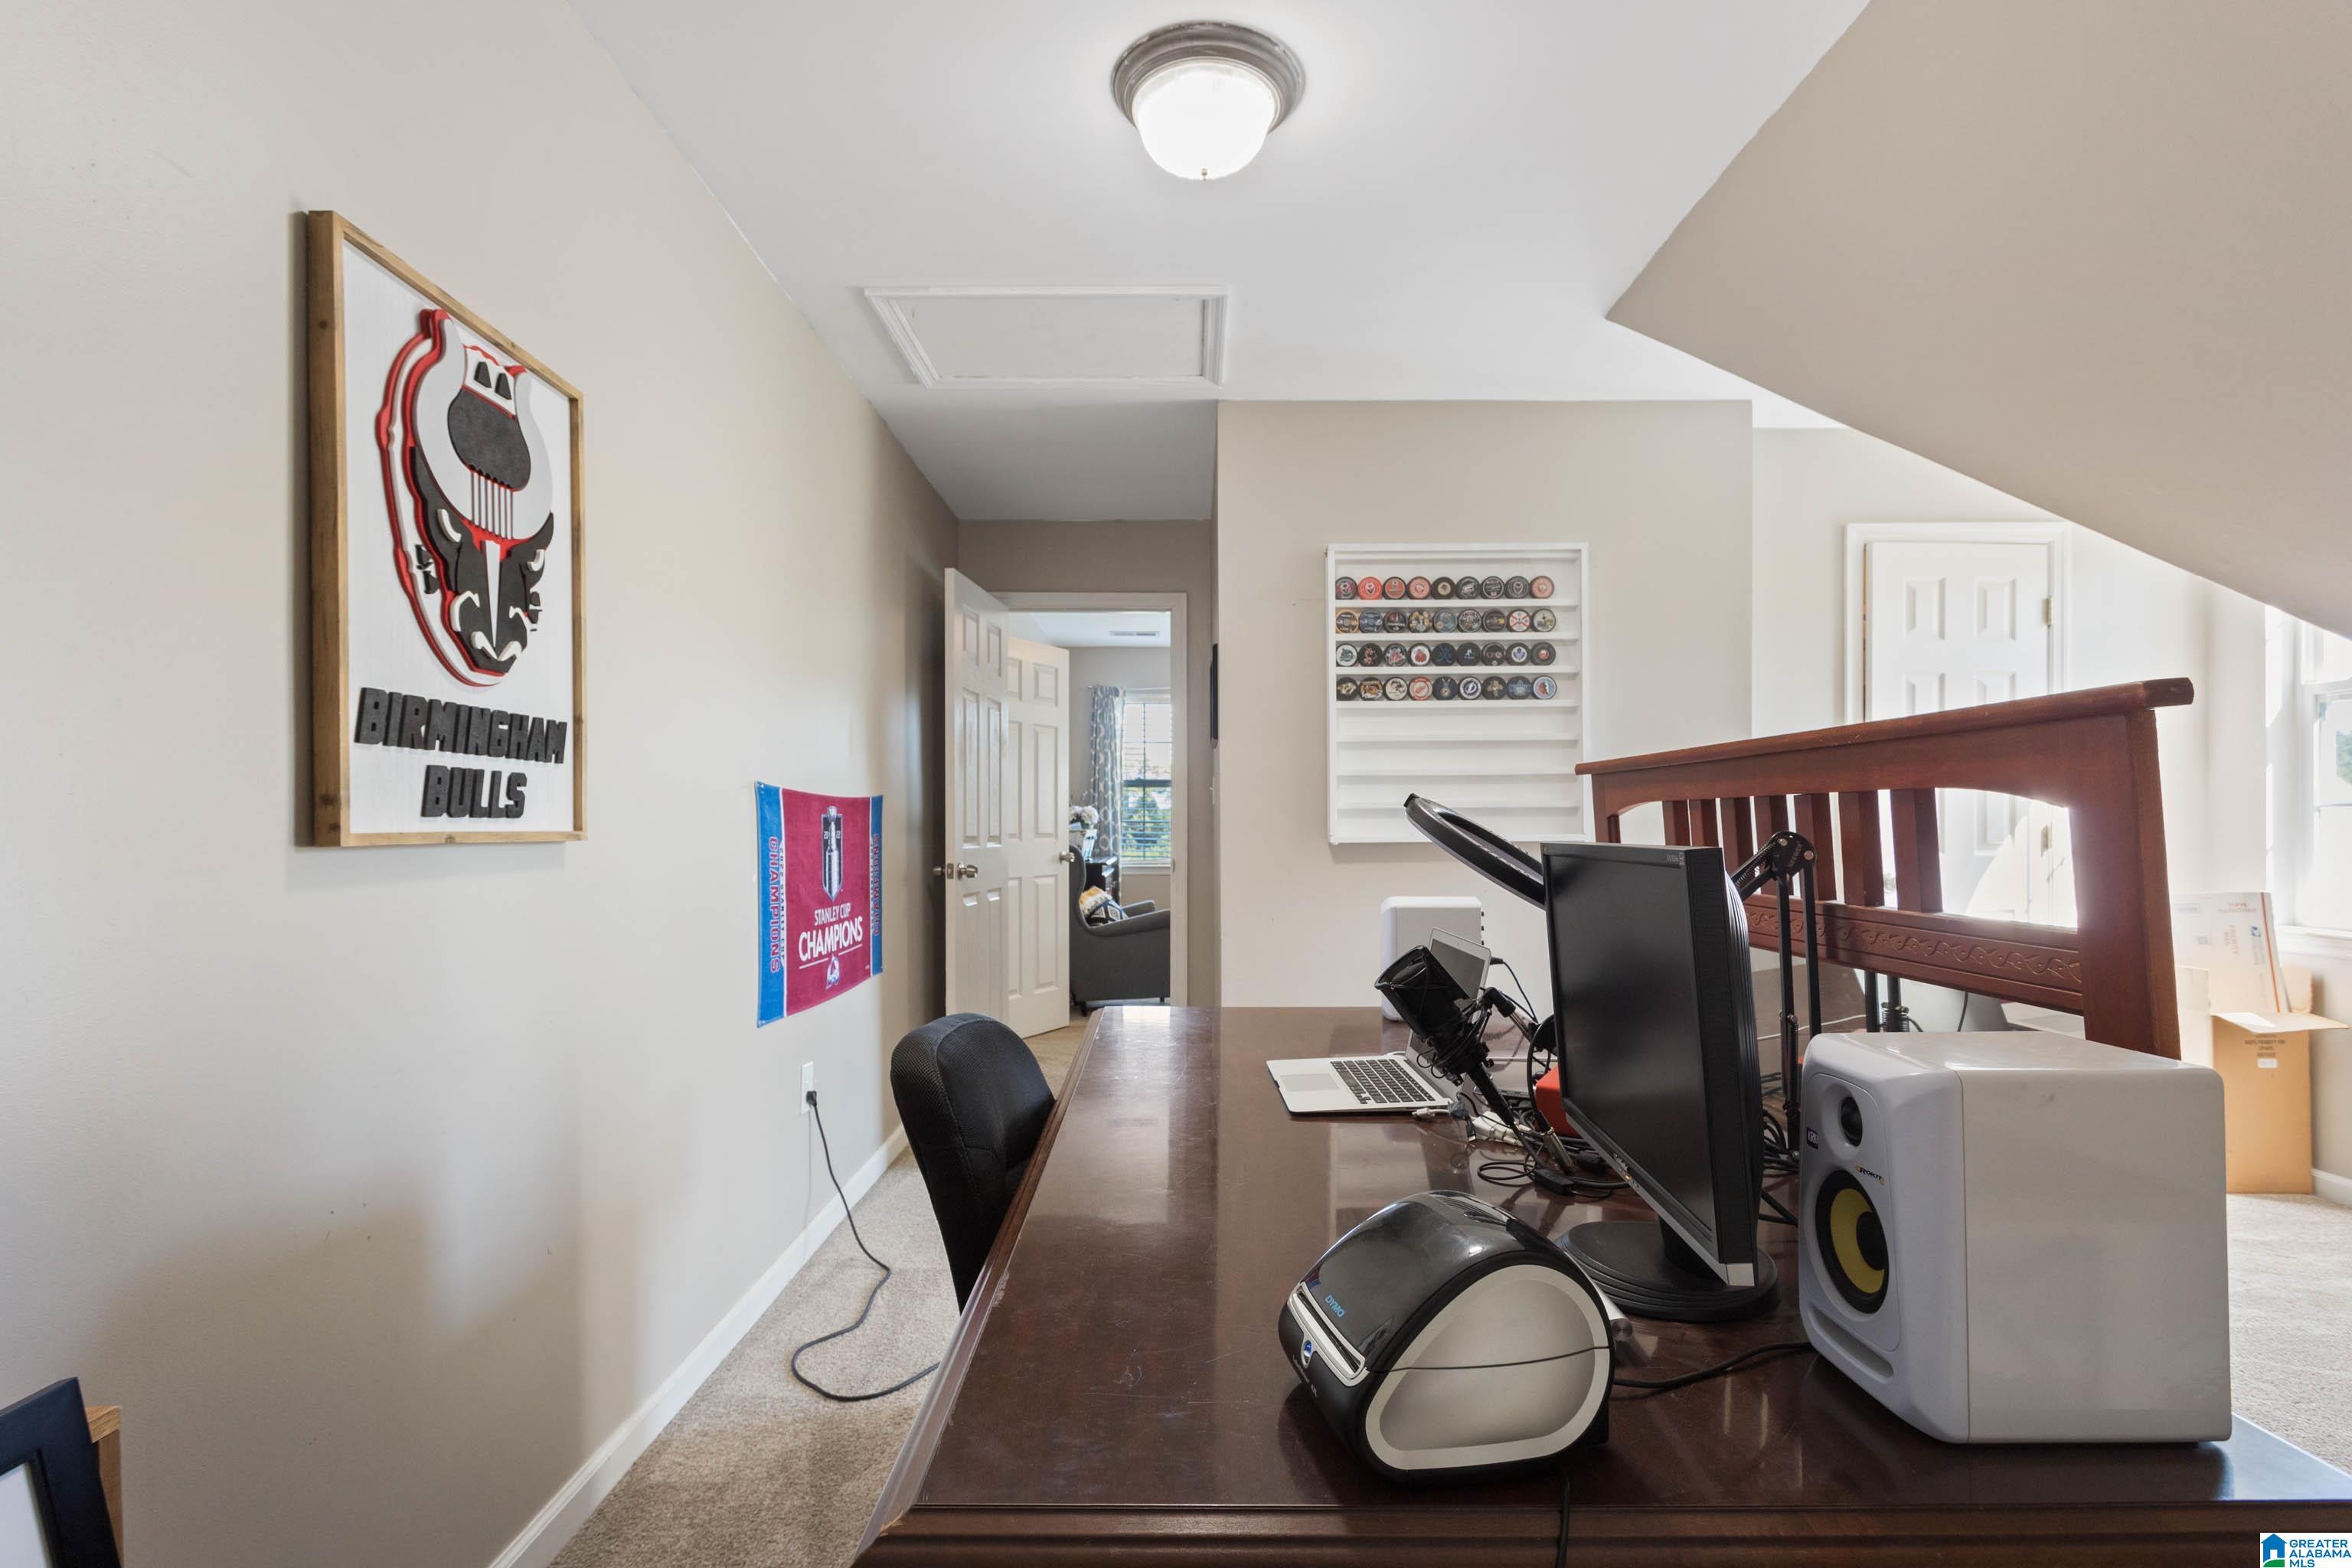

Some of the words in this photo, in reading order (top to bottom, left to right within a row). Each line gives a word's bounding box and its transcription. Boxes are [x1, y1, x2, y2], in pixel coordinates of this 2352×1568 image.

[354, 687, 567, 764] BIRMINGHAM
[420, 765, 528, 818] BULLS
[823, 830, 828, 840] 20
[835, 830, 841, 839] 22
[769, 836, 779, 973] CHAMPIONS
[814, 905, 840, 926] STANLEY
[840, 902, 851, 920] CUP
[798, 915, 864, 962] CHAMPIONS
[1325, 1294, 1345, 1318] DYMO
